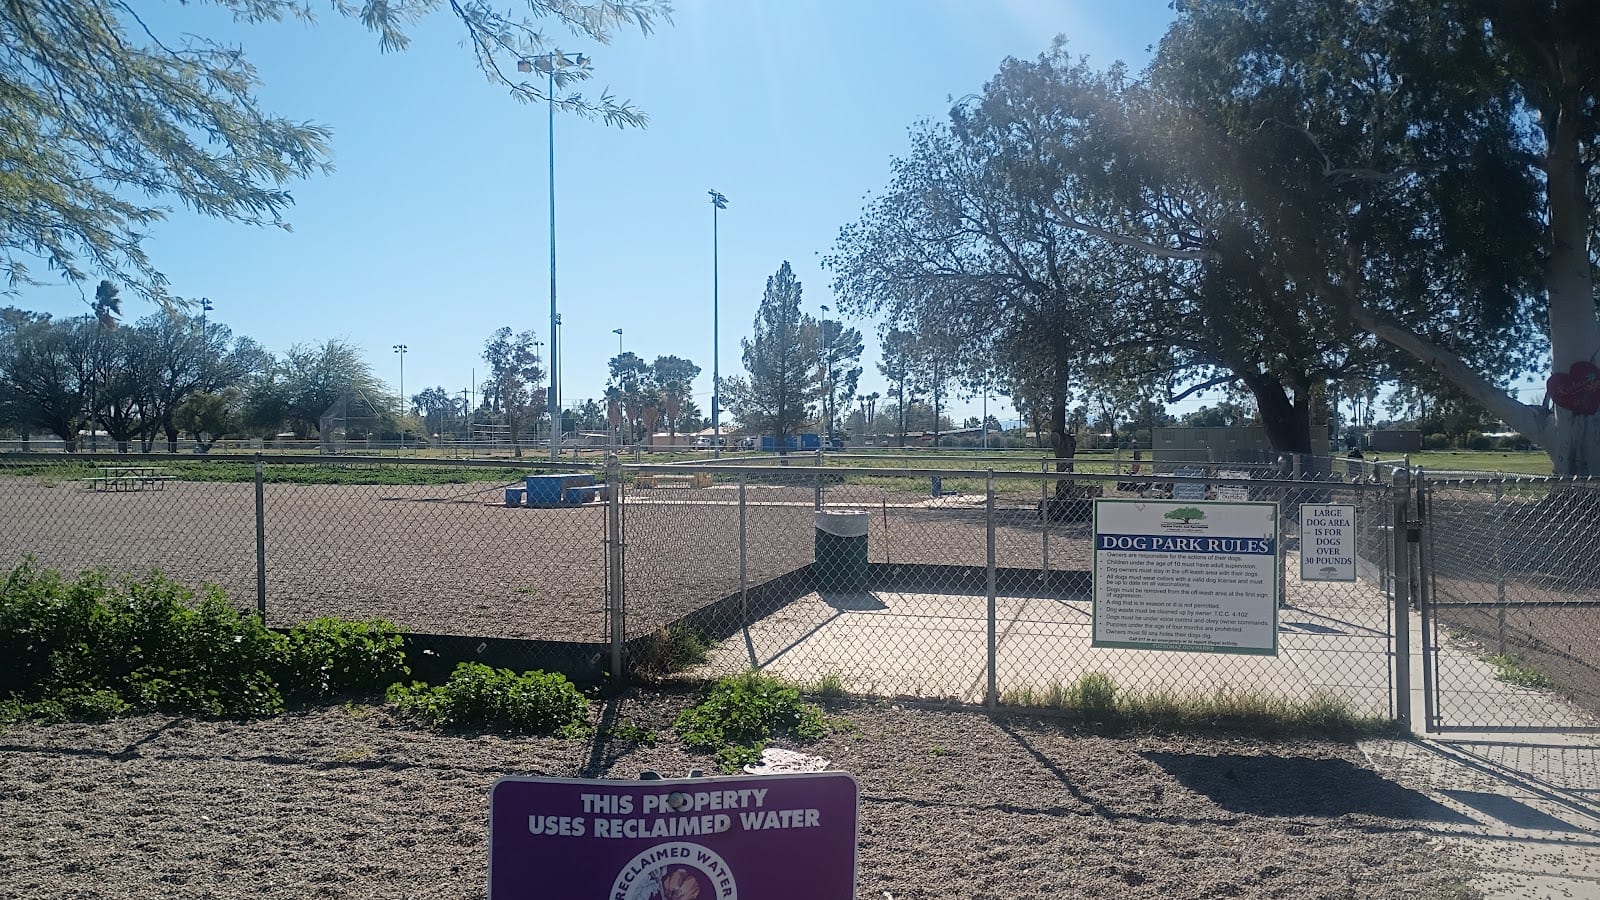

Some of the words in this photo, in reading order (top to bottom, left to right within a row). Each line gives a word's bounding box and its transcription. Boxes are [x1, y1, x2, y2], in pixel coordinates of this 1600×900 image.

[1102, 536, 1146, 549] DOG
[1152, 537, 1202, 551] PARK
[1208, 539, 1269, 553] RULES
[581, 793, 634, 814] THIS
[643, 788, 769, 814] PROPERTY
[528, 815, 585, 836] USES
[594, 814, 731, 839] RECLAIMED
[740, 808, 820, 831] WATER
[614, 847, 690, 900] RECLAIMED
[697, 850, 732, 898] WATER
